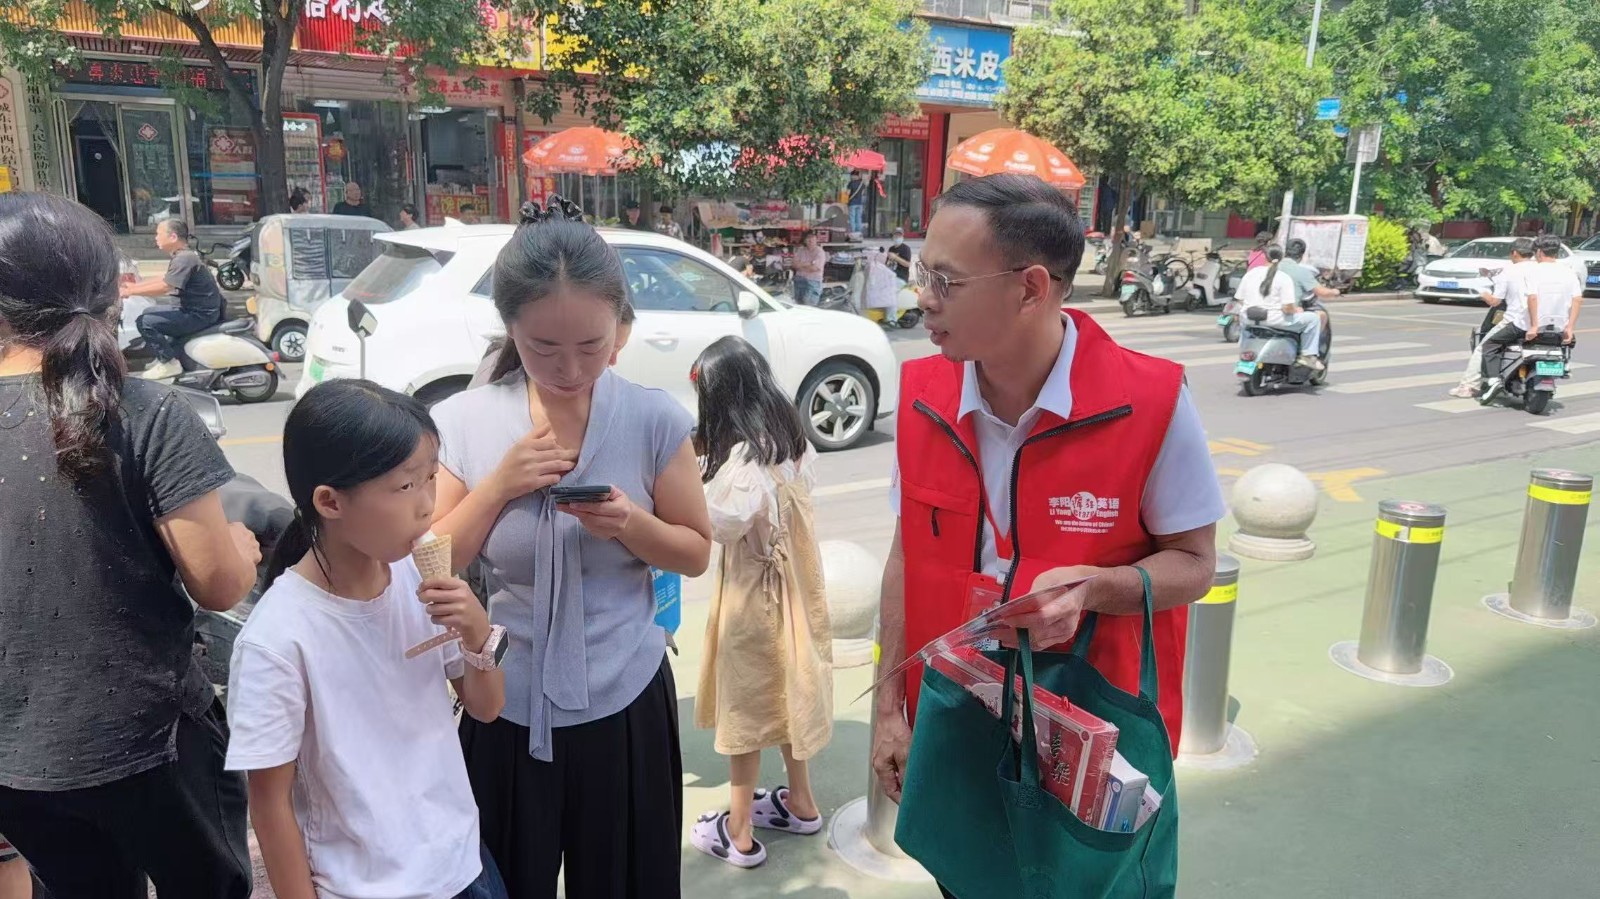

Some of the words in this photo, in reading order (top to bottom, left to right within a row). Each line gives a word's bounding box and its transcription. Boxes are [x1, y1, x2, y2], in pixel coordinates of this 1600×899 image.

[931, 46, 1000, 81] 西米皮
[1048, 496, 1071, 508] 李阳
[1097, 497, 1120, 509] 英语
[1096, 509, 1119, 518] English
